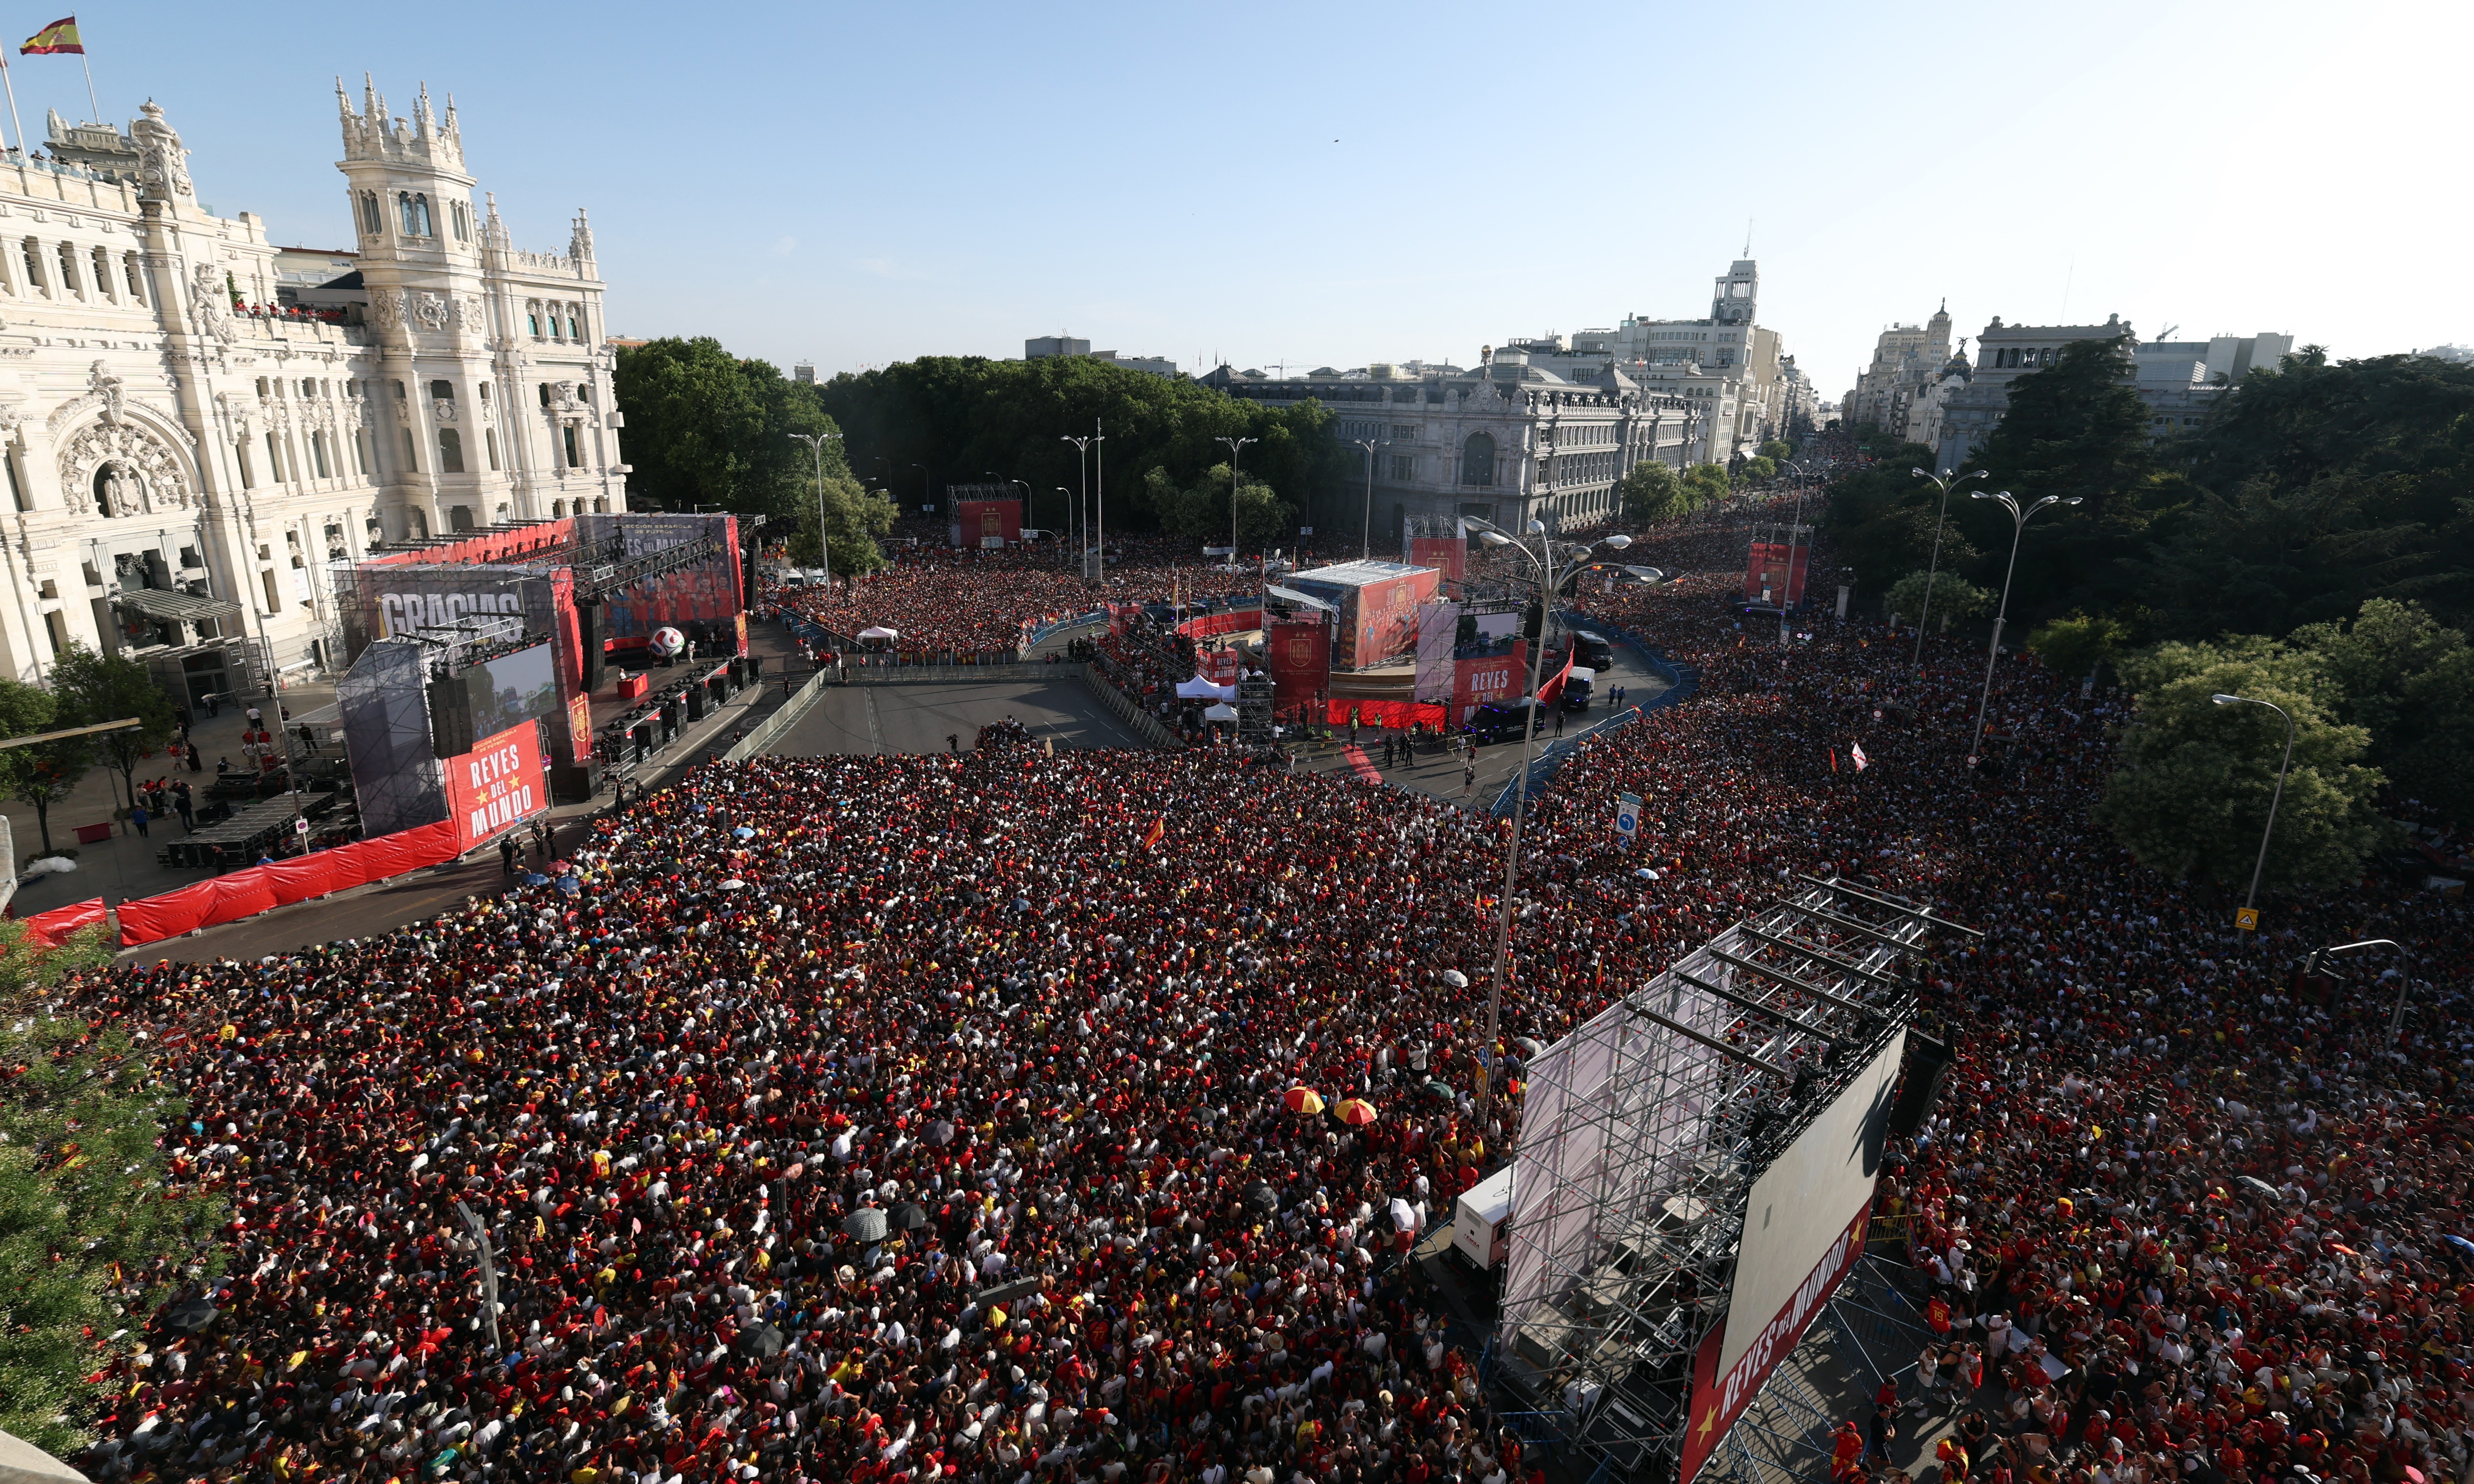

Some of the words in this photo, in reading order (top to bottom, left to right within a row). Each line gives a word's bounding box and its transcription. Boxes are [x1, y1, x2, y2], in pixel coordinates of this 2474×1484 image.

[644, 543, 655, 551] DEL
[1387, 589, 1395, 606] 20
[1407, 584, 1415, 600] 26
[381, 593, 523, 641] GRACIAS
[1217, 657, 1232, 665] REYES
[1214, 669, 1234, 678] MUNDO
[1472, 670, 1508, 691] REYES
[1482, 692, 1493, 702] DEL
[472, 740, 492, 751] ECCIÓN
[493, 729, 517, 742] ESPAÑOLA
[487, 739, 506, 749] FÚTBOL
[470, 744, 520, 789] REYES
[490, 780, 507, 798] DEL
[471, 784, 532, 838] MUNDO
[729, 1108, 737, 1118] 12
[423, 1244, 430, 1253] 2
[1472, 1261, 1477, 1269] V
[1934, 1310, 1943, 1322] 19
[1720, 1320, 1777, 1421] REYES
[1776, 1310, 1791, 1341] DEL
[1788, 1230, 1849, 1335] MUNDO
[1093, 1331, 1105, 1342] 77
[1113, 1388, 1119, 1398] 2
